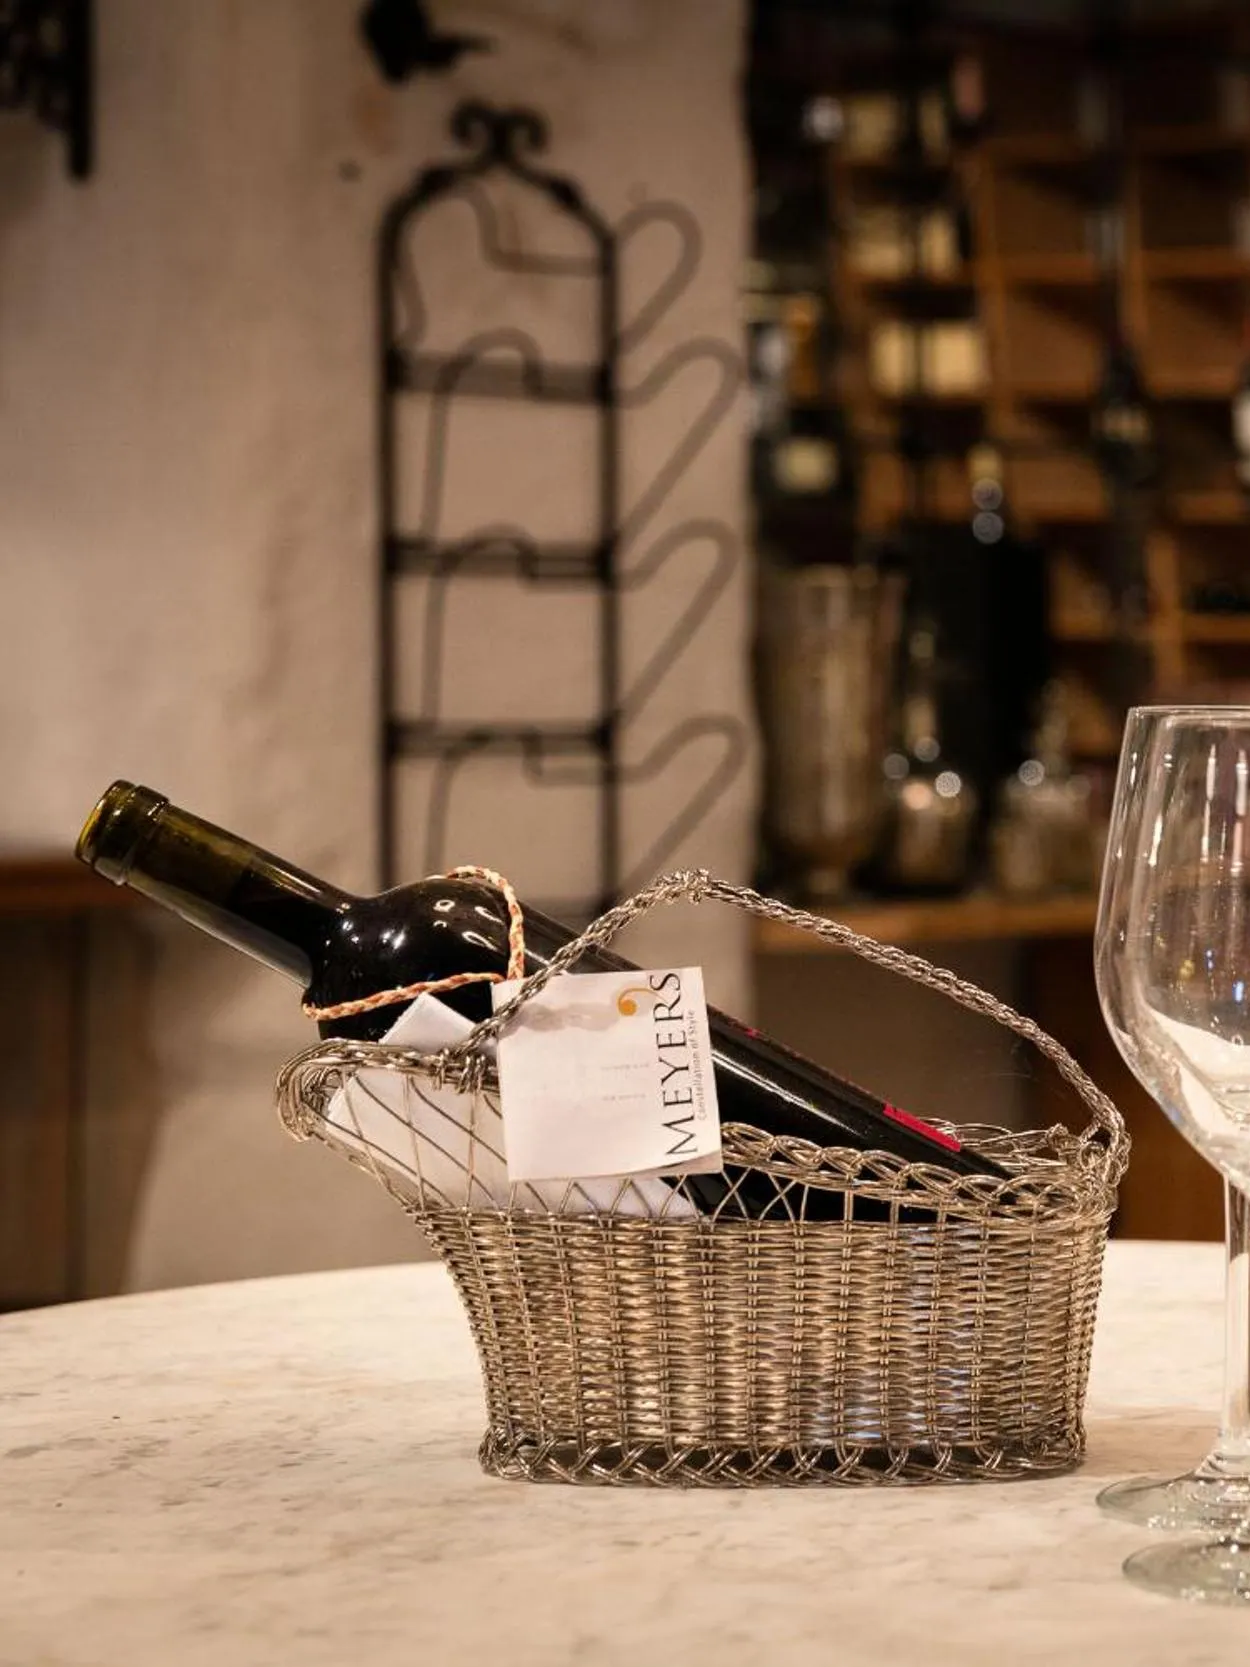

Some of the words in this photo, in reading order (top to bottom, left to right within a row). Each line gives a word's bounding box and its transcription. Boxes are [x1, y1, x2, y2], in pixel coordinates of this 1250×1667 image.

[686, 1010, 697, 1035] Style
[649, 972, 698, 1155] MEYERS
[692, 1052, 707, 1121] Constellation
